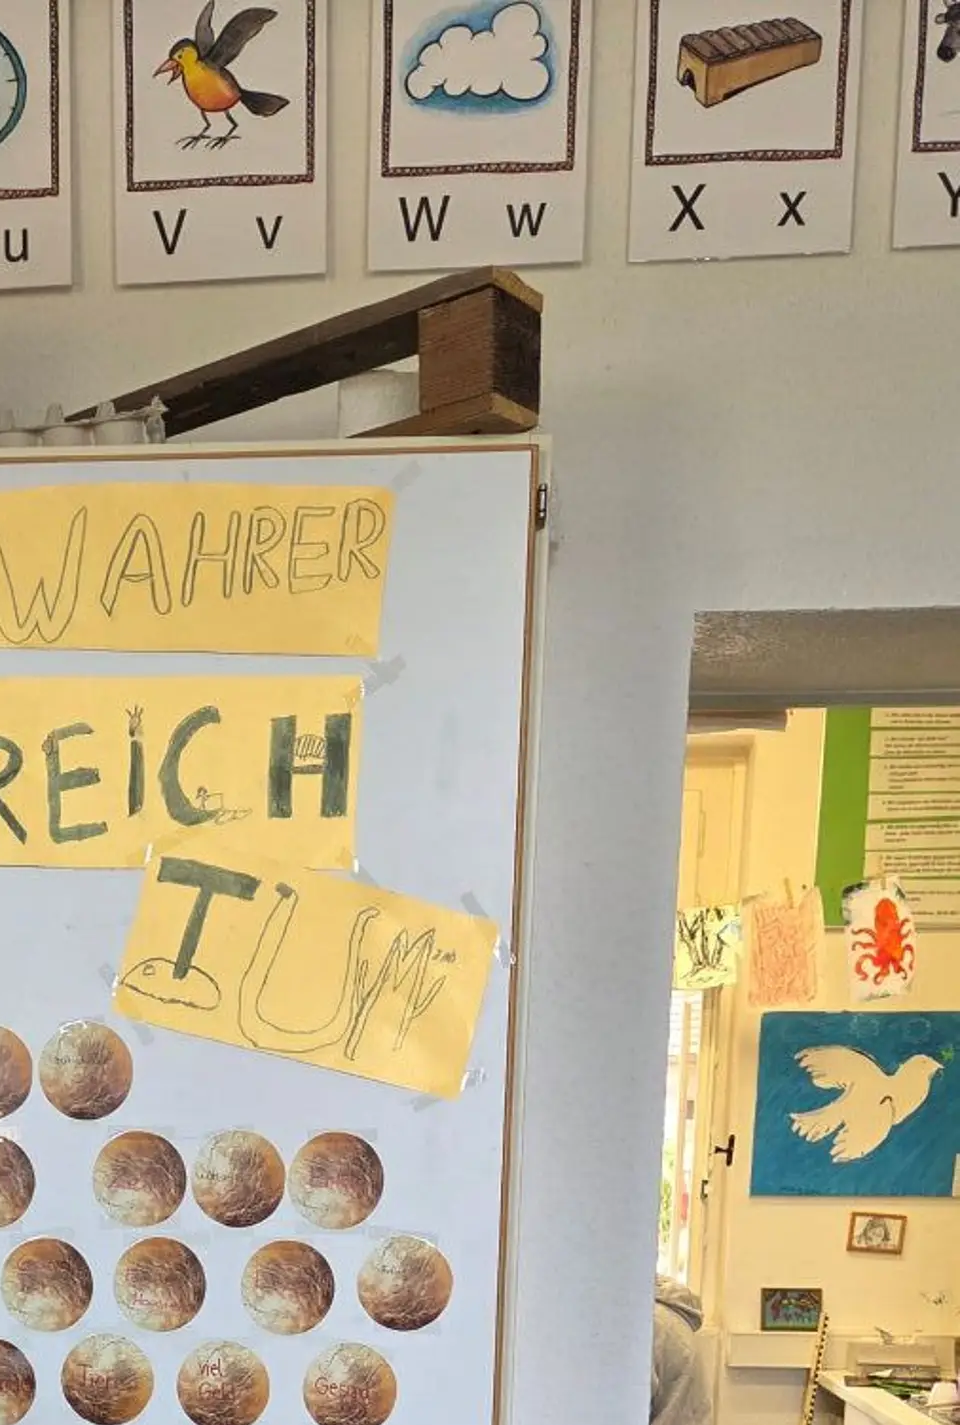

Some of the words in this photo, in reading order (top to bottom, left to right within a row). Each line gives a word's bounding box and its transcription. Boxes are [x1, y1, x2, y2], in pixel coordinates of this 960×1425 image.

[669, 184, 706, 231] X
[777, 193, 805, 227] x
[937, 171, 960, 218] Y
[153, 210, 187, 255] V
[255, 215, 283, 250] v
[398, 197, 451, 241] W
[506, 202, 548, 237] w
[3, 228, 29, 261] u
[198, 1358, 224, 1378] viel
